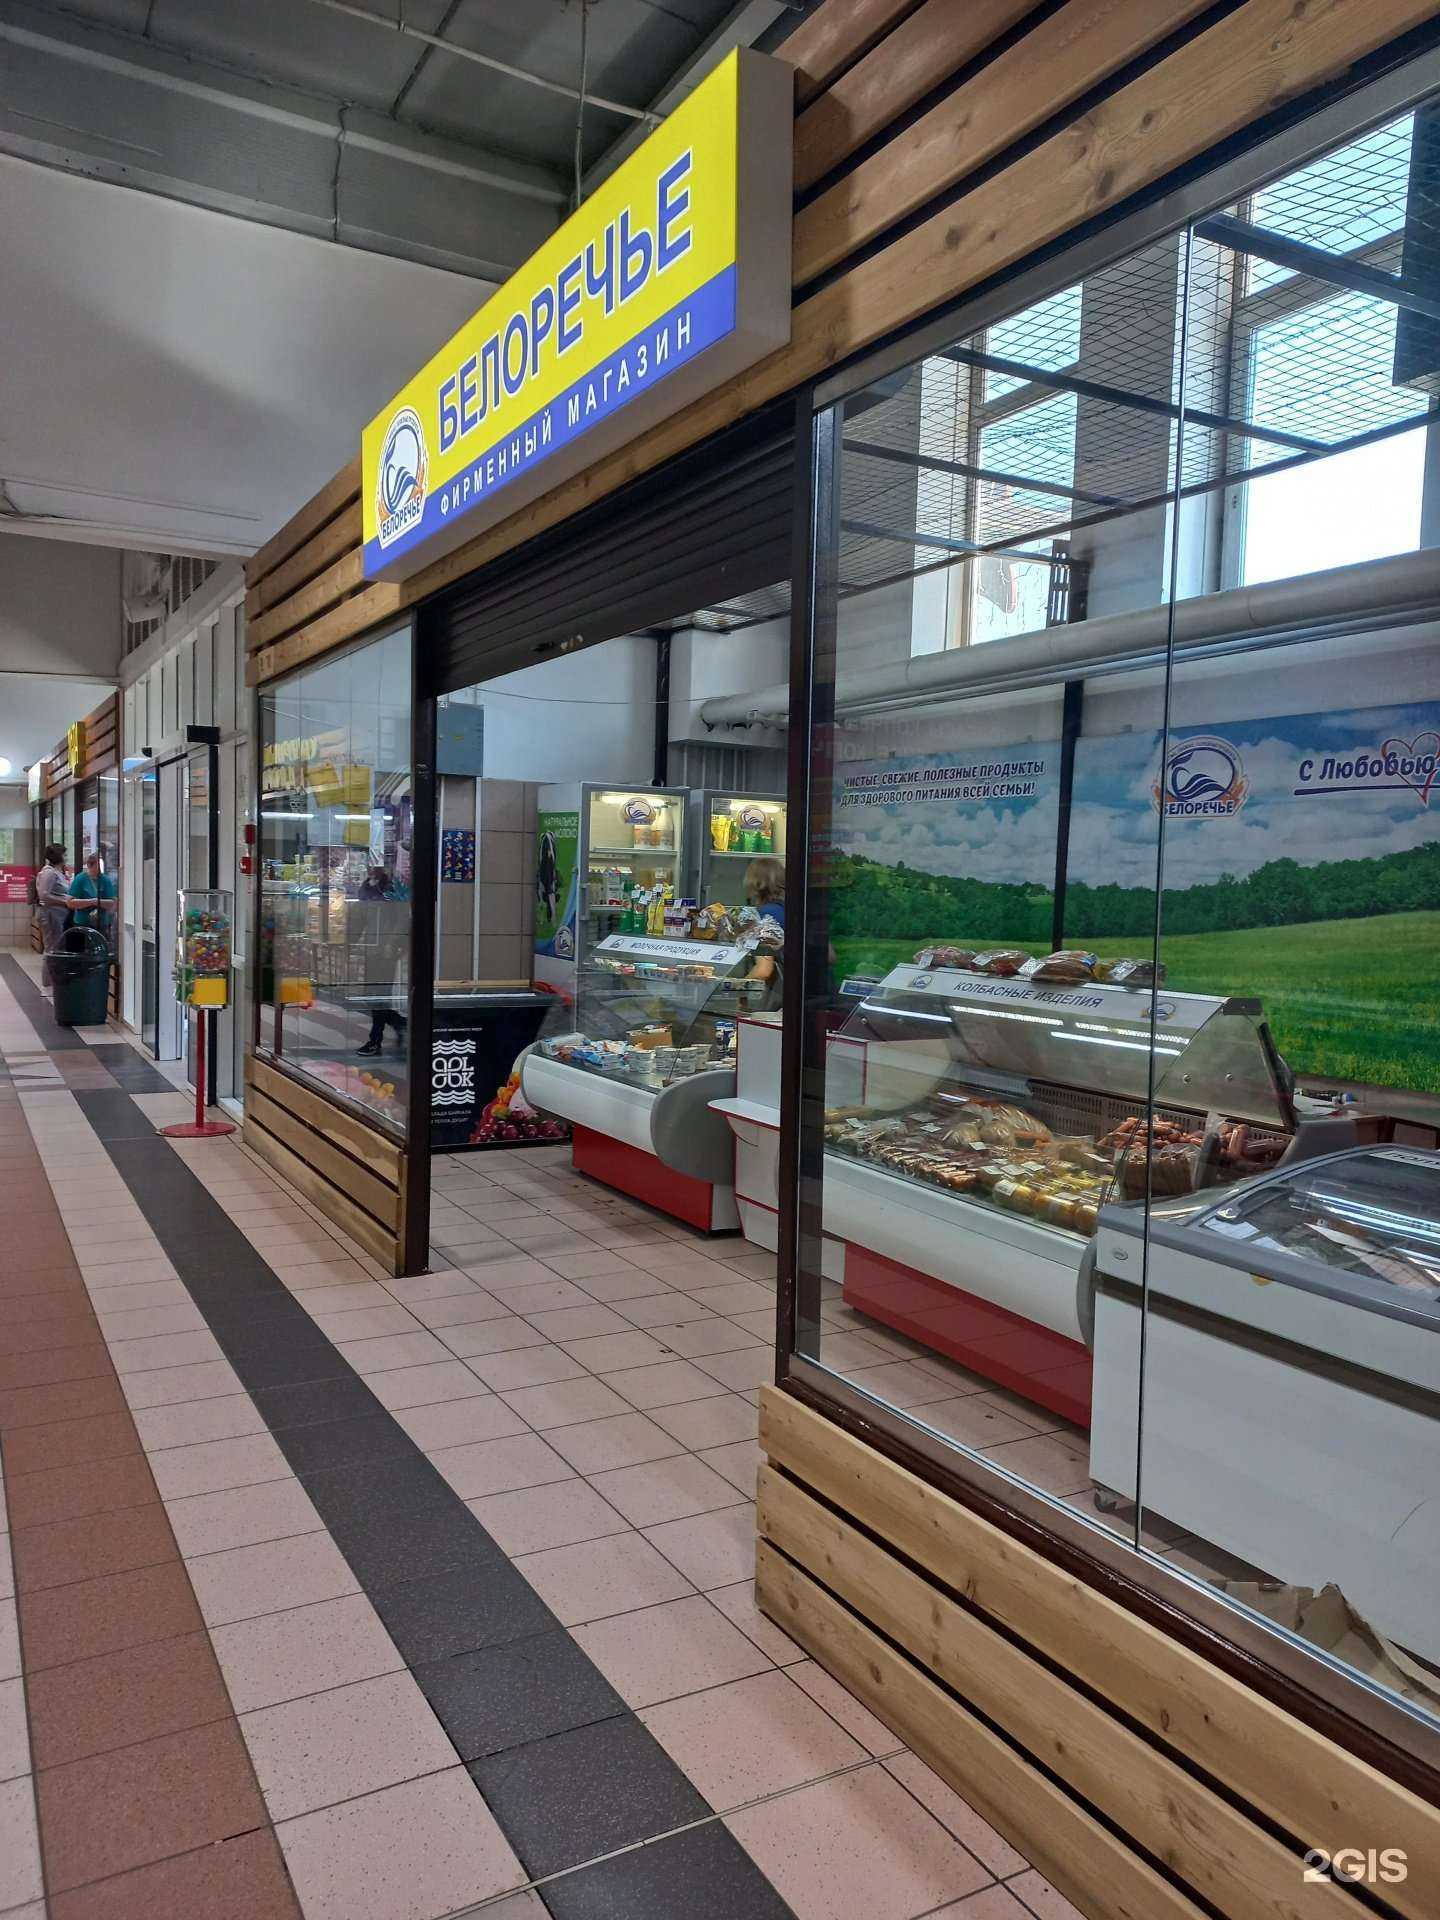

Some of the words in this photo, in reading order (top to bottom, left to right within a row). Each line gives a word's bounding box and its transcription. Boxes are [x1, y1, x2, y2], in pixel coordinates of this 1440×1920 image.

[438, 147, 693, 456] БЕЛОРЕЧЬЕ
[440, 409, 552, 516] ФИРМЕННЫЙ
[568, 311, 692, 426] МАГАЗИН
[382, 495, 421, 539] БЕЛОРЕЧЬЕ
[923, 766, 978, 781] ПОЛЕЗНЫЕ
[980, 761, 1044, 777] ПРОДУКТЫ
[1299, 759, 1314, 781] С
[1319, 752, 1436, 780] Любовью
[840, 792, 860, 807] ДЛЯ
[861, 790, 913, 806] ЗДОРОВОГО
[915, 787, 961, 801] ПИТАНИЯ
[963, 782, 991, 798] ВСЕЙ
[993, 782, 1035, 797] СЕМЬИ!
[953, 981, 1032, 1000] КОЛБАСНЫЕ
[1032, 990, 1104, 1008] ИЗДЕЛИЯ
